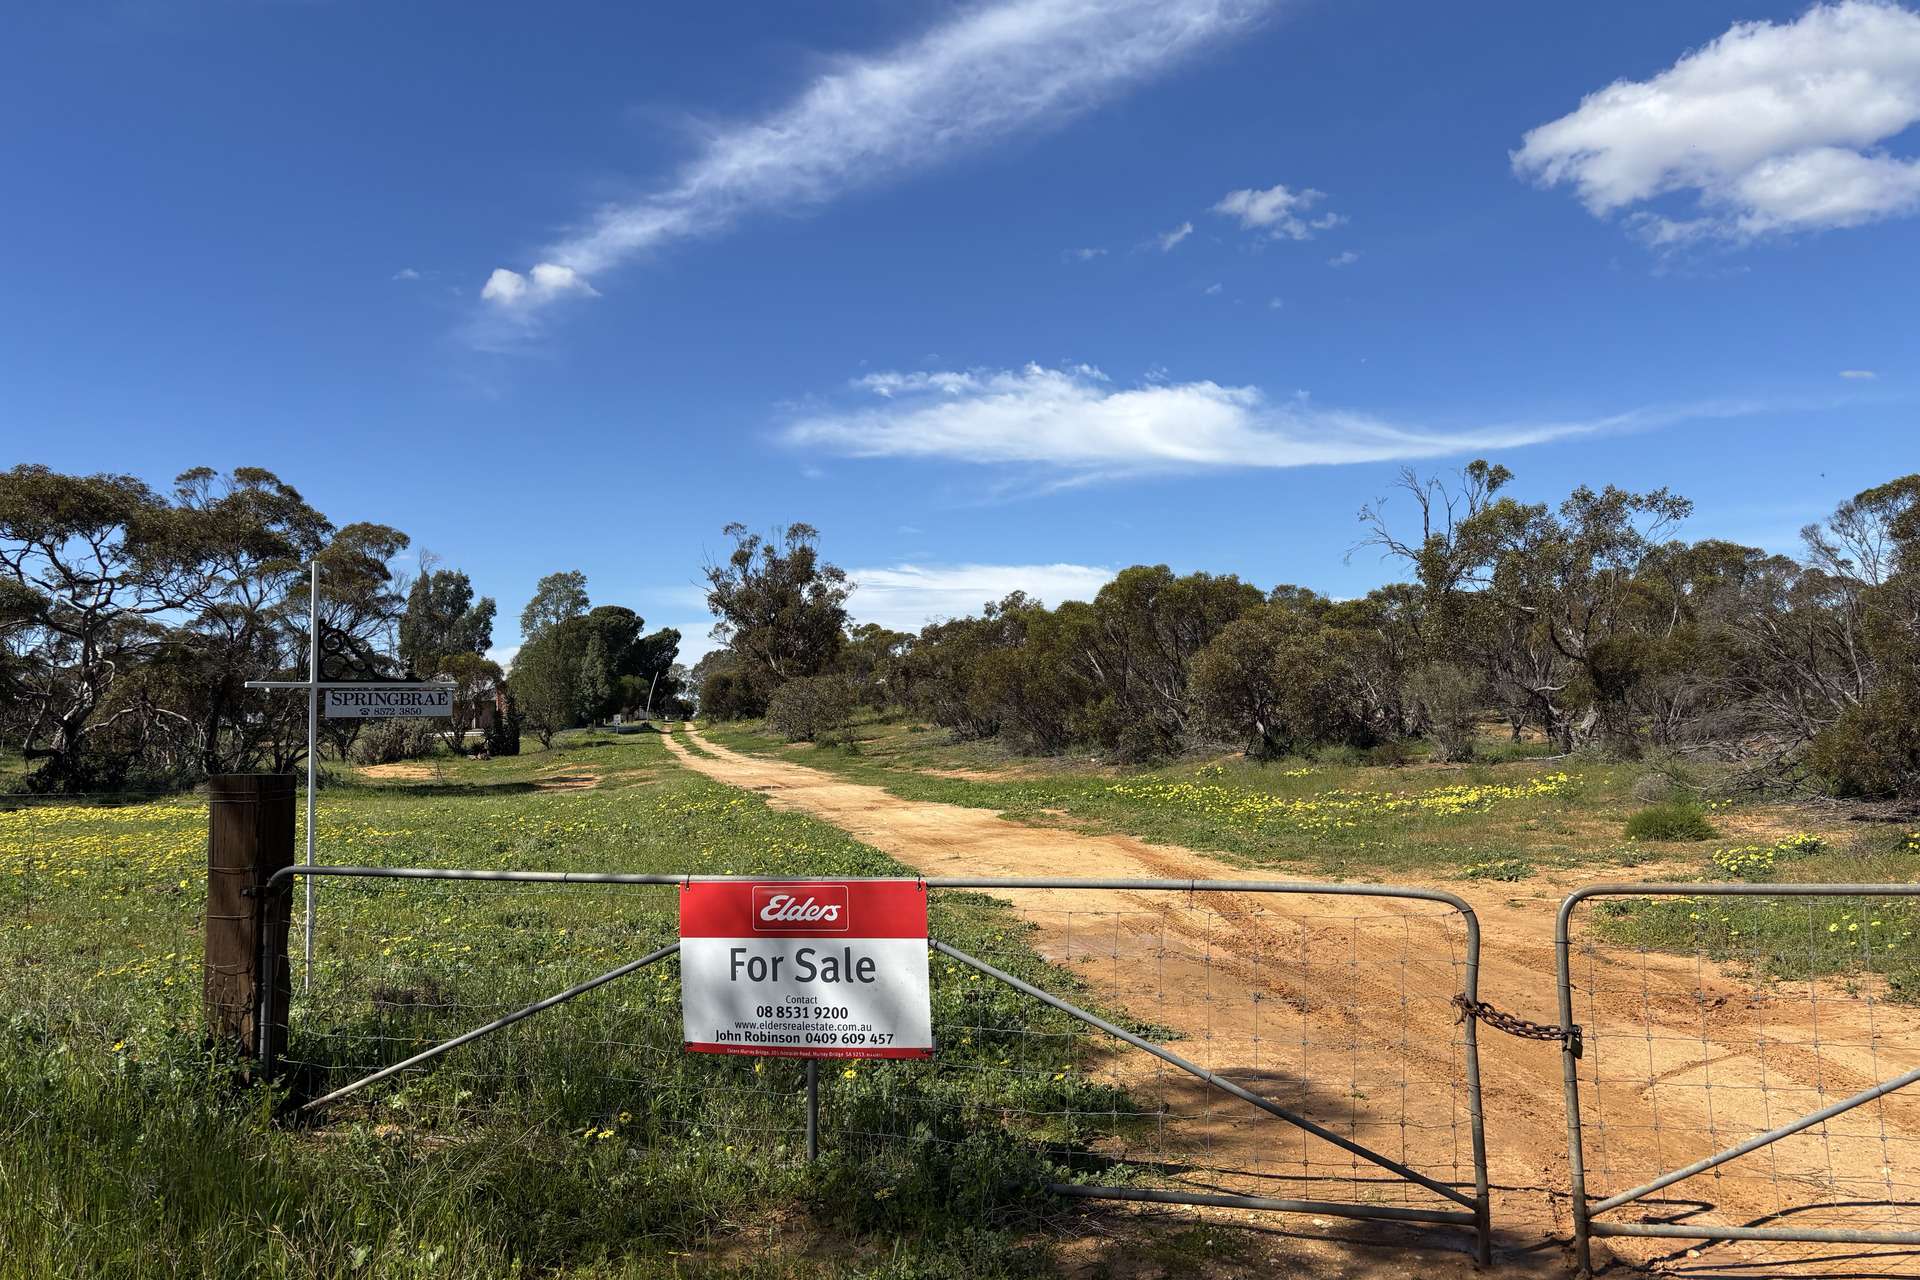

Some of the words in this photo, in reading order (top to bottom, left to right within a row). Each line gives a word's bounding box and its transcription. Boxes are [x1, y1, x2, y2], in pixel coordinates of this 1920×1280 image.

[331, 692, 448, 706] SPRINGBRAE
[374, 707, 396, 716] 8572
[399, 707, 422, 716] 3850
[759, 894, 842, 922] Elders
[730, 947, 785, 982] For
[795, 946, 876, 984] Sale
[785, 995, 818, 1005] Contact
[756, 1005, 773, 1018] 08
[776, 1006, 809, 1019] 8531
[814, 1006, 849, 1020] 9200
[734, 1020, 872, 1032] www.eldersrealestate.com.au
[715, 1029, 741, 1042] John
[744, 1031, 801, 1043] Robinson
[805, 1032, 838, 1044] 0409
[841, 1033, 866, 1045] 609
[869, 1033, 894, 1045] 457
